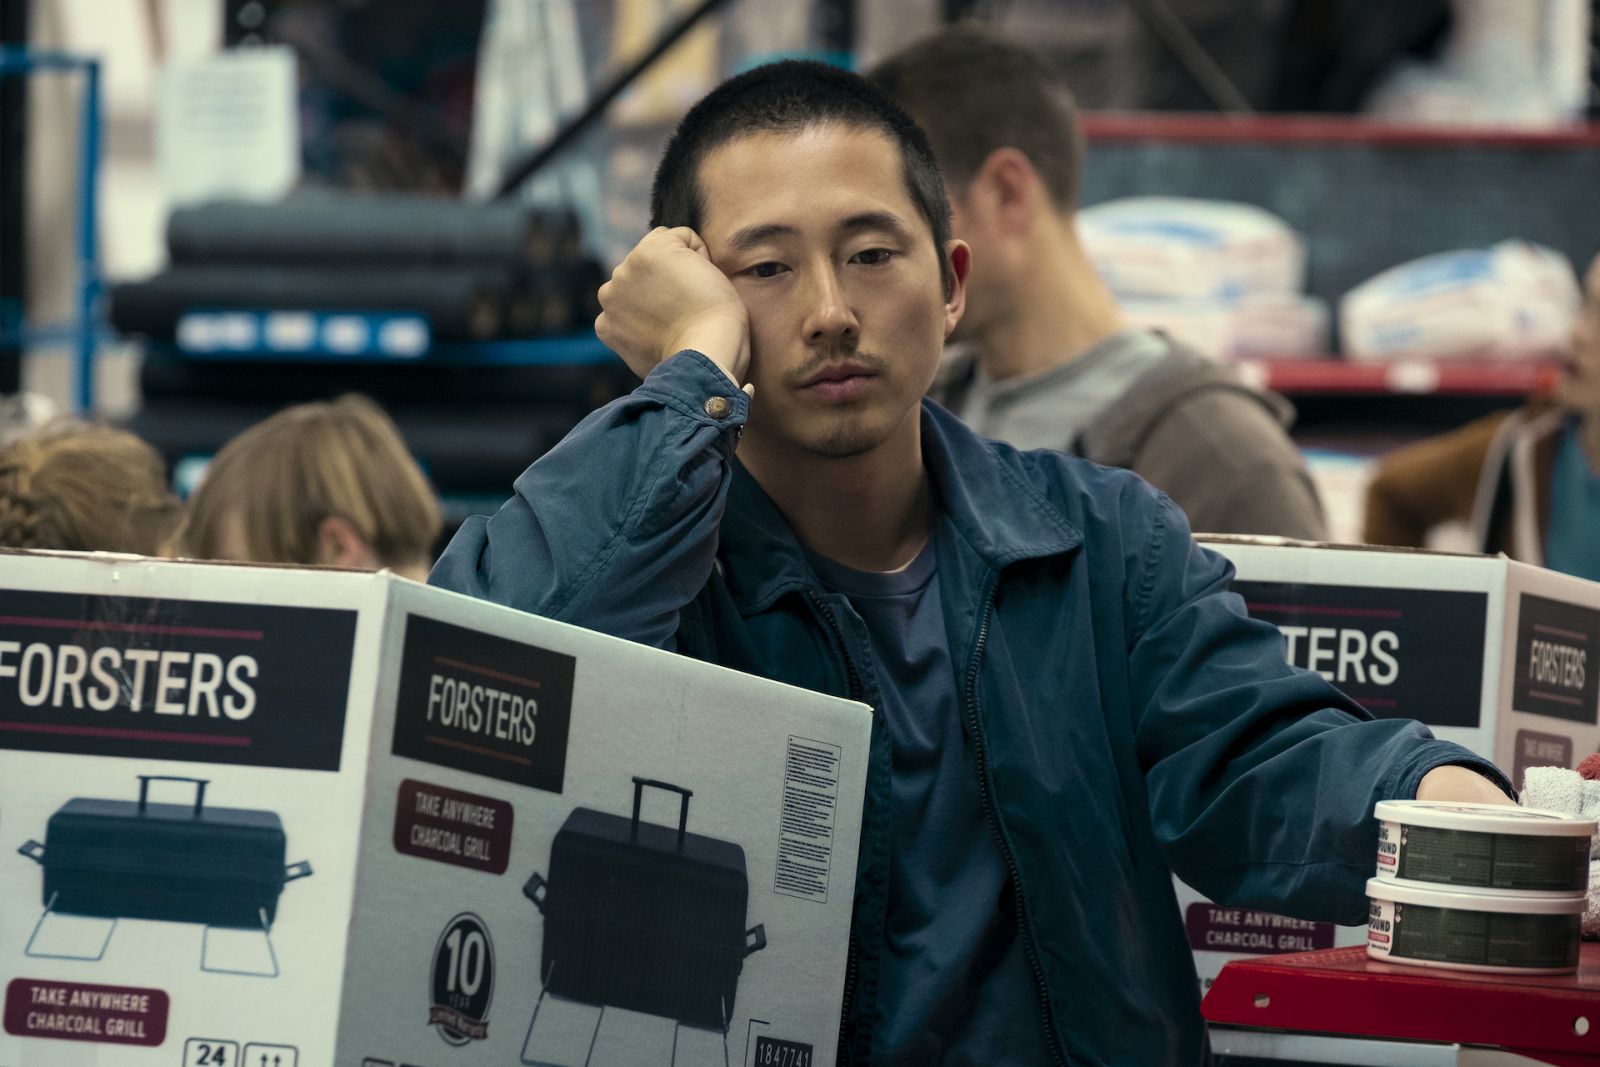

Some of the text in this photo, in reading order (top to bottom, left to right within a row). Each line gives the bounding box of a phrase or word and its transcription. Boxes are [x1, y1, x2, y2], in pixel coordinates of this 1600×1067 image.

[1280, 625, 1400, 686] TERS
[1529, 639, 1588, 691] FORSTERS
[0, 641, 259, 720] FORSTERS
[427, 674, 538, 746] FORSTERS
[415, 791, 497, 830] TAKE ANYWHERE
[410, 824, 491, 861] CHARCOAL GRILL
[1208, 909, 1241, 926] TAKE
[1206, 930, 1315, 951] CHARCOAL GRILL
[446, 928, 486, 996] 10
[31, 986, 149, 1013] TAKE ANYWHERE
[27, 1012, 147, 1039] CHARCOAL GRILL
[196, 1044, 226, 1066] 24
[759, 1042, 810, 1067] 1847741
